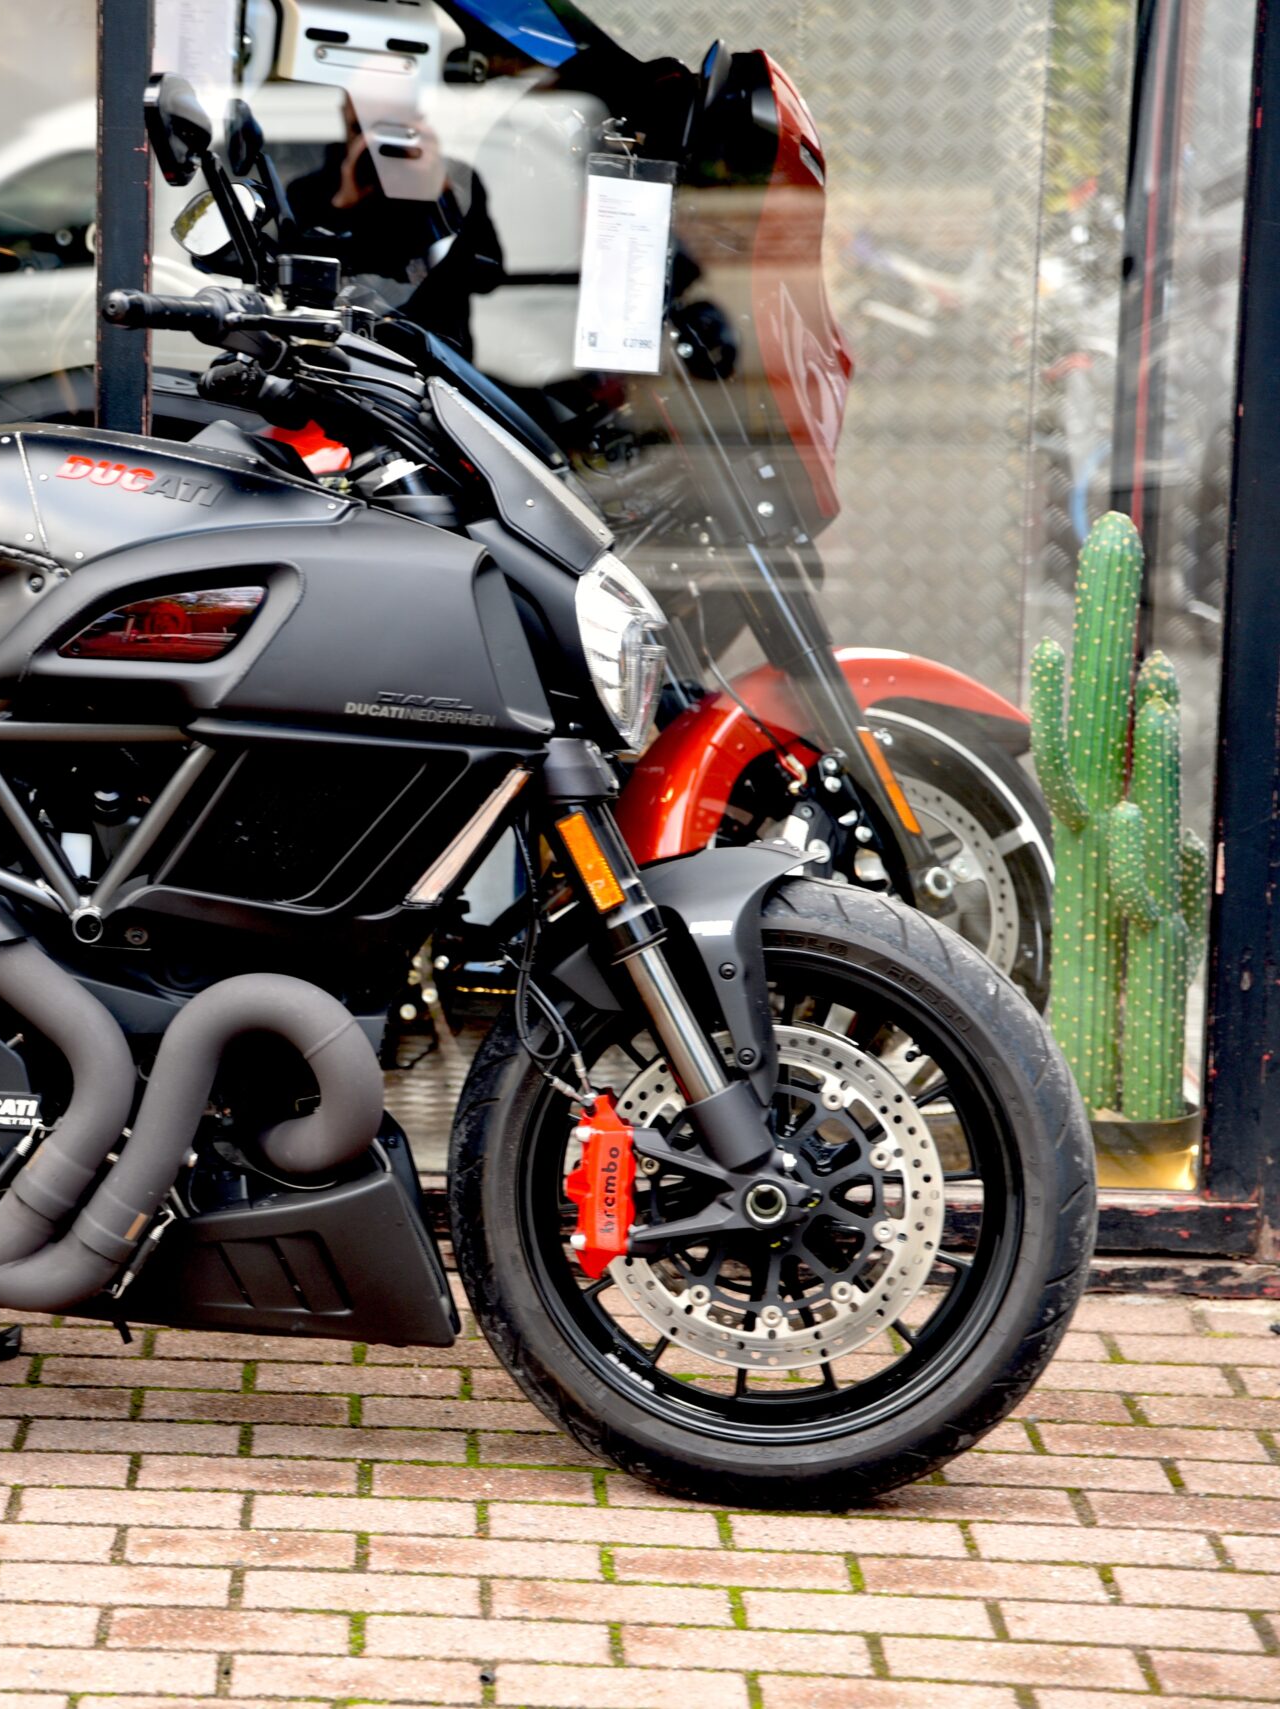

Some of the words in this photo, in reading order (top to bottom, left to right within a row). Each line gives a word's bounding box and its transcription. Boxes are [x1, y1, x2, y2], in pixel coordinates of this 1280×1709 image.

[56, 454, 224, 507] DUCATI
[376, 690, 474, 711] DIAVEL
[599, 1146, 620, 1234] brembo
